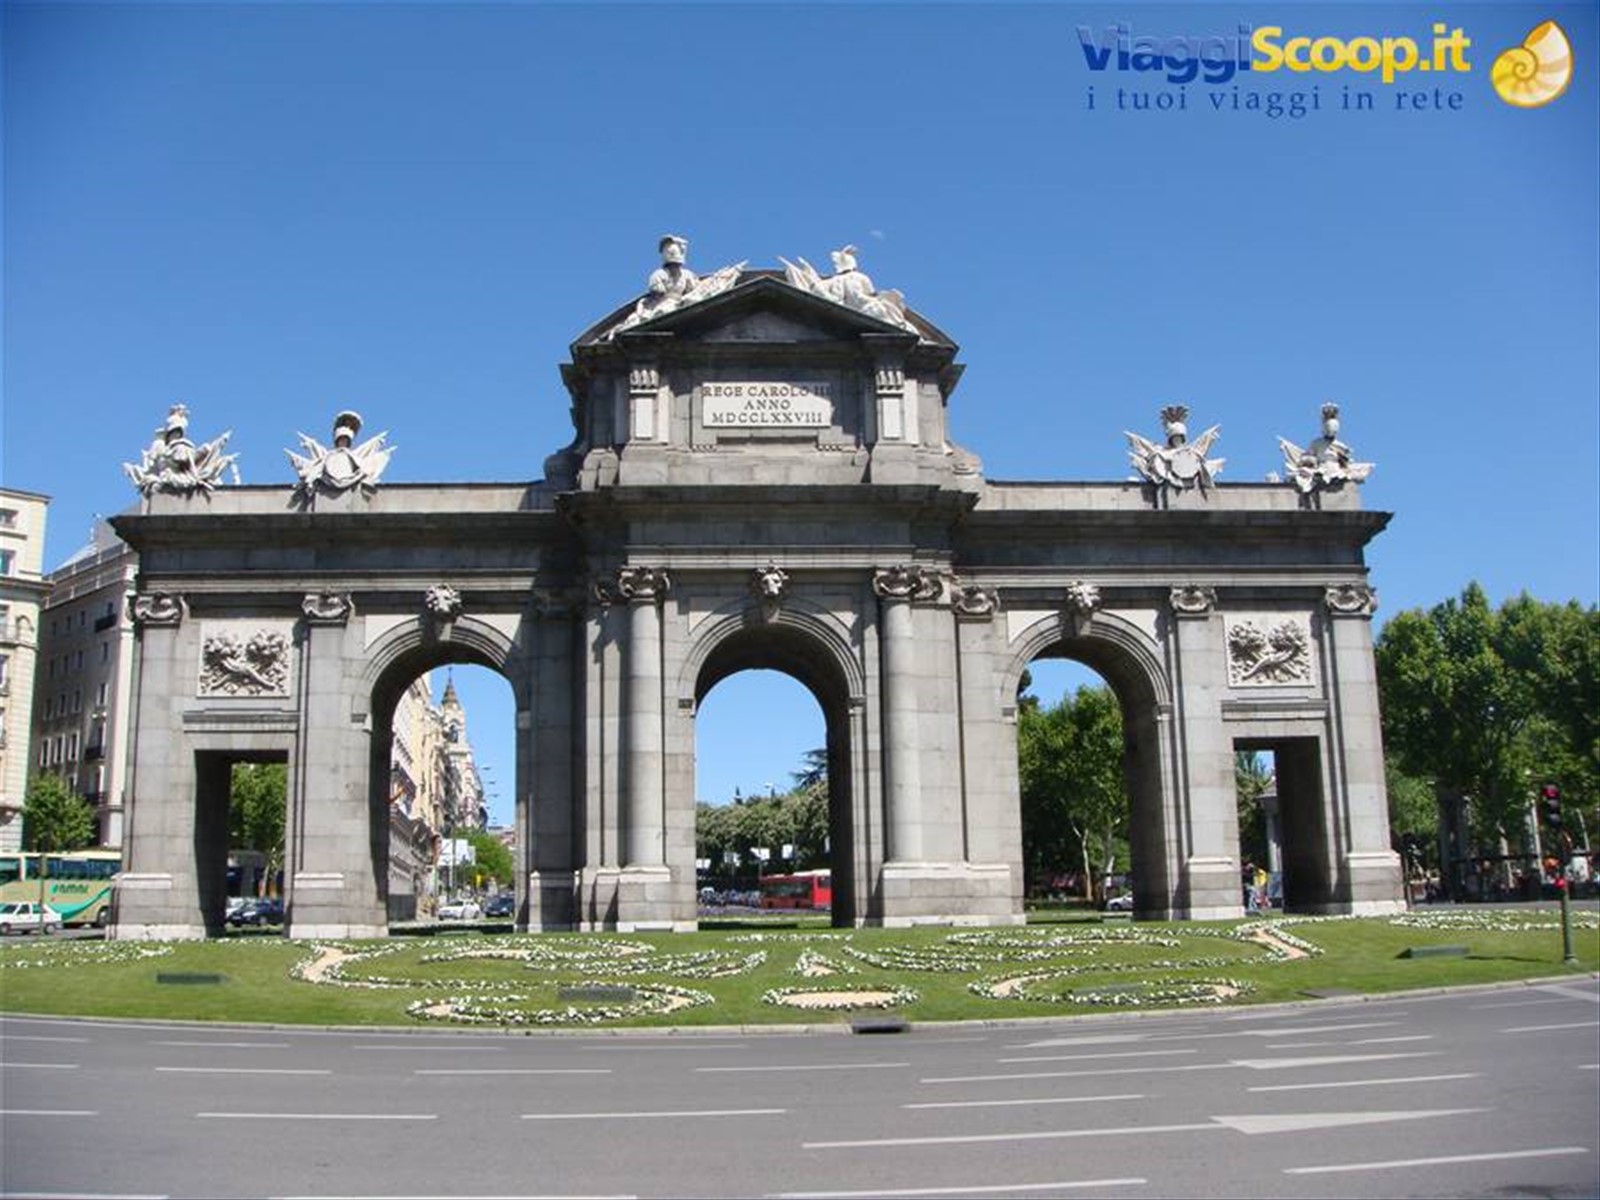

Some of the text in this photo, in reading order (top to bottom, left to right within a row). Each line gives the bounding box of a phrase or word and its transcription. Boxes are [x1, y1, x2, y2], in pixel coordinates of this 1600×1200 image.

[702, 386, 743, 397] REGE
[747, 386, 809, 397] CAROLO
[744, 399, 791, 410] ANNO
[712, 412, 823, 424] MDCCLXXVIII
